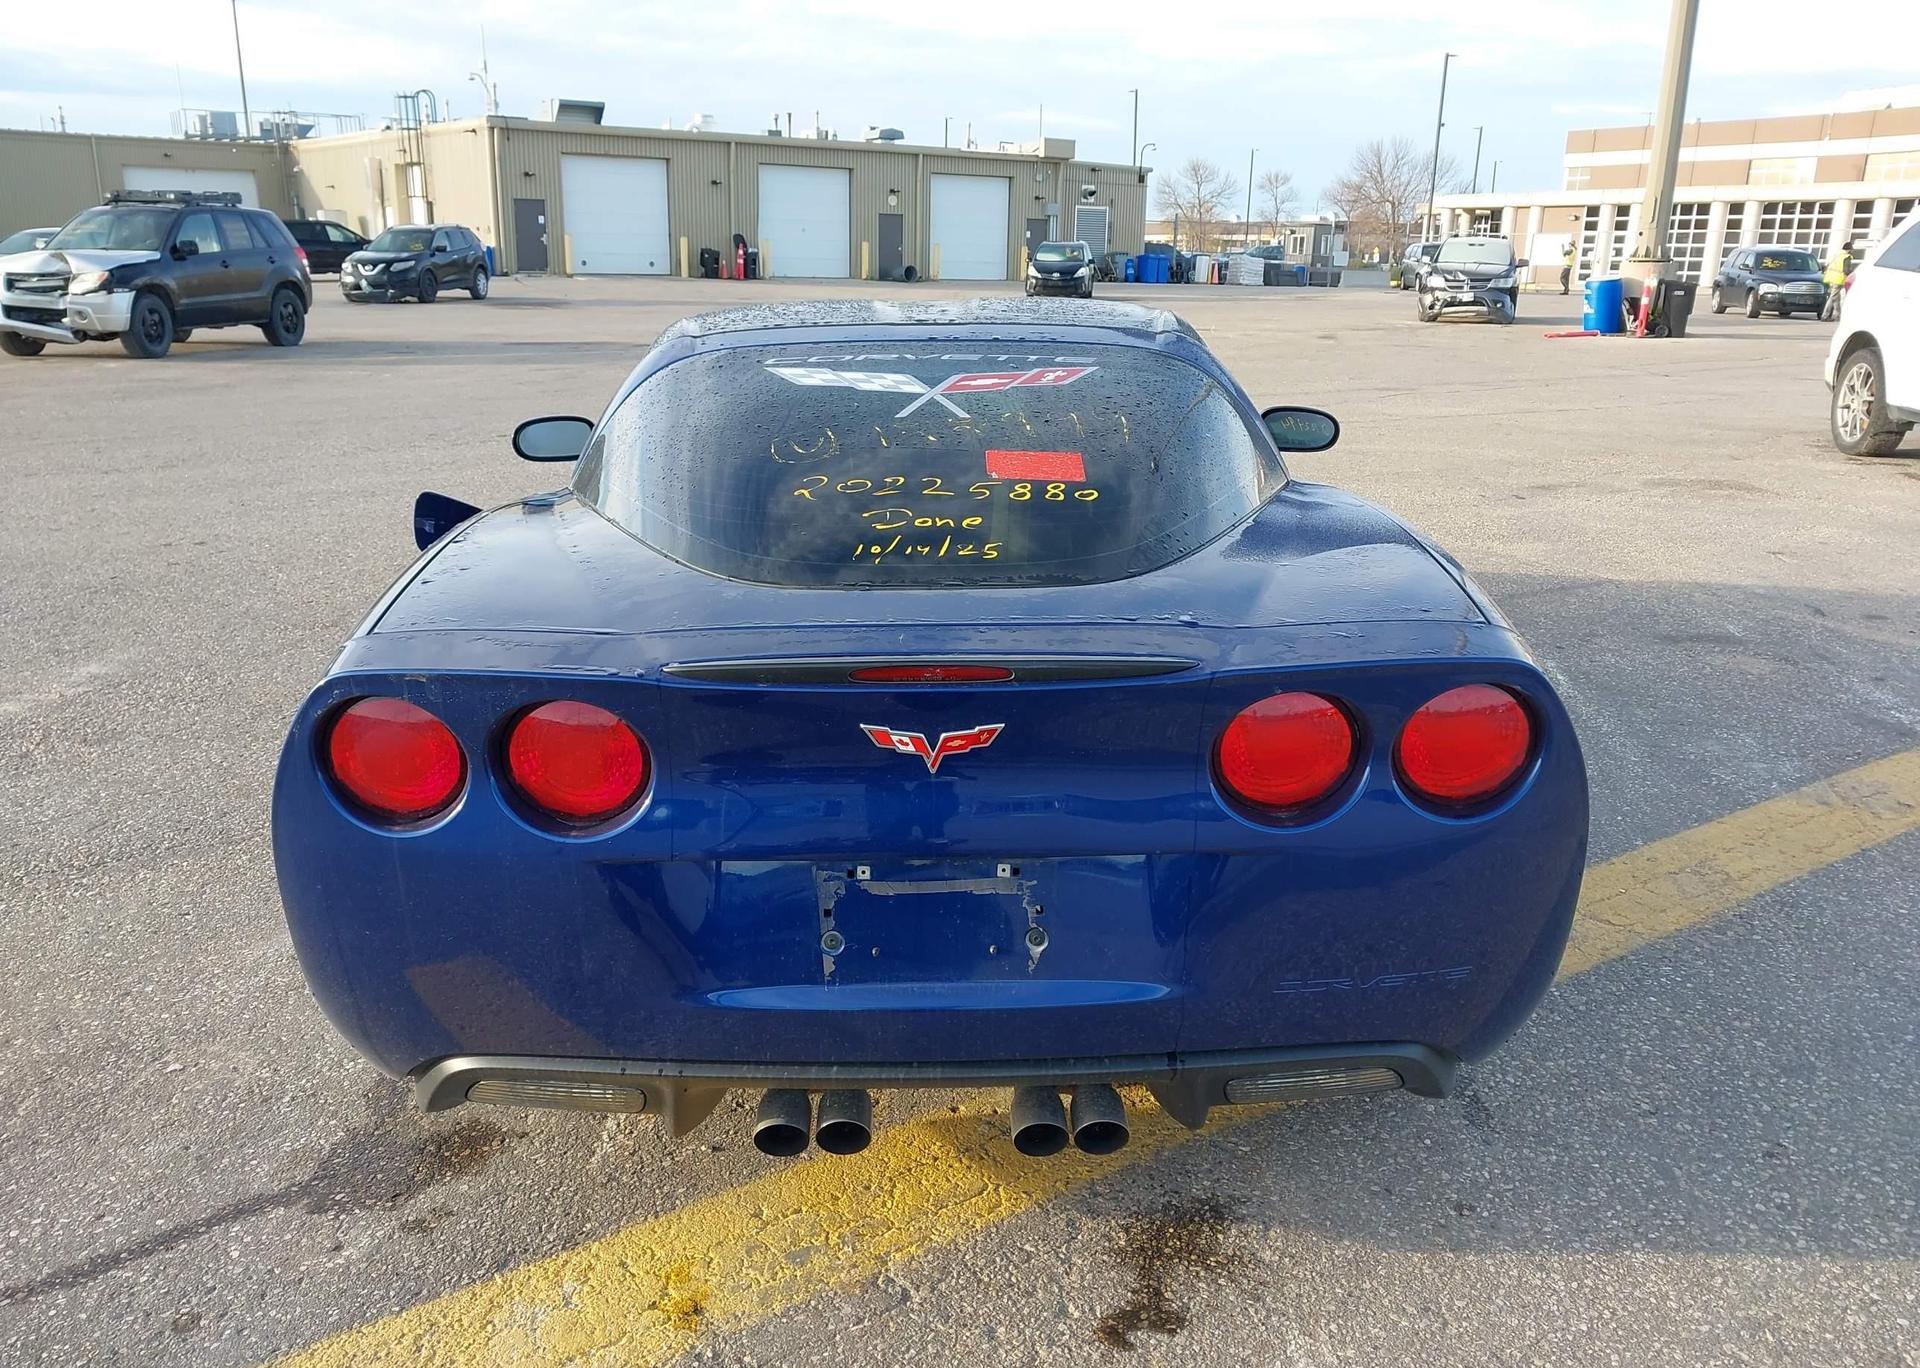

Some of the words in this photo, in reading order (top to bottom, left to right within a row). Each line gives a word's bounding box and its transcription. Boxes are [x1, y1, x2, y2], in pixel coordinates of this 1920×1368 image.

[763, 354, 1099, 365] CORVETTE
[793, 475, 1100, 501] 20225880
[861, 508, 985, 530] Done
[852, 535, 1003, 564] 10/14/25
